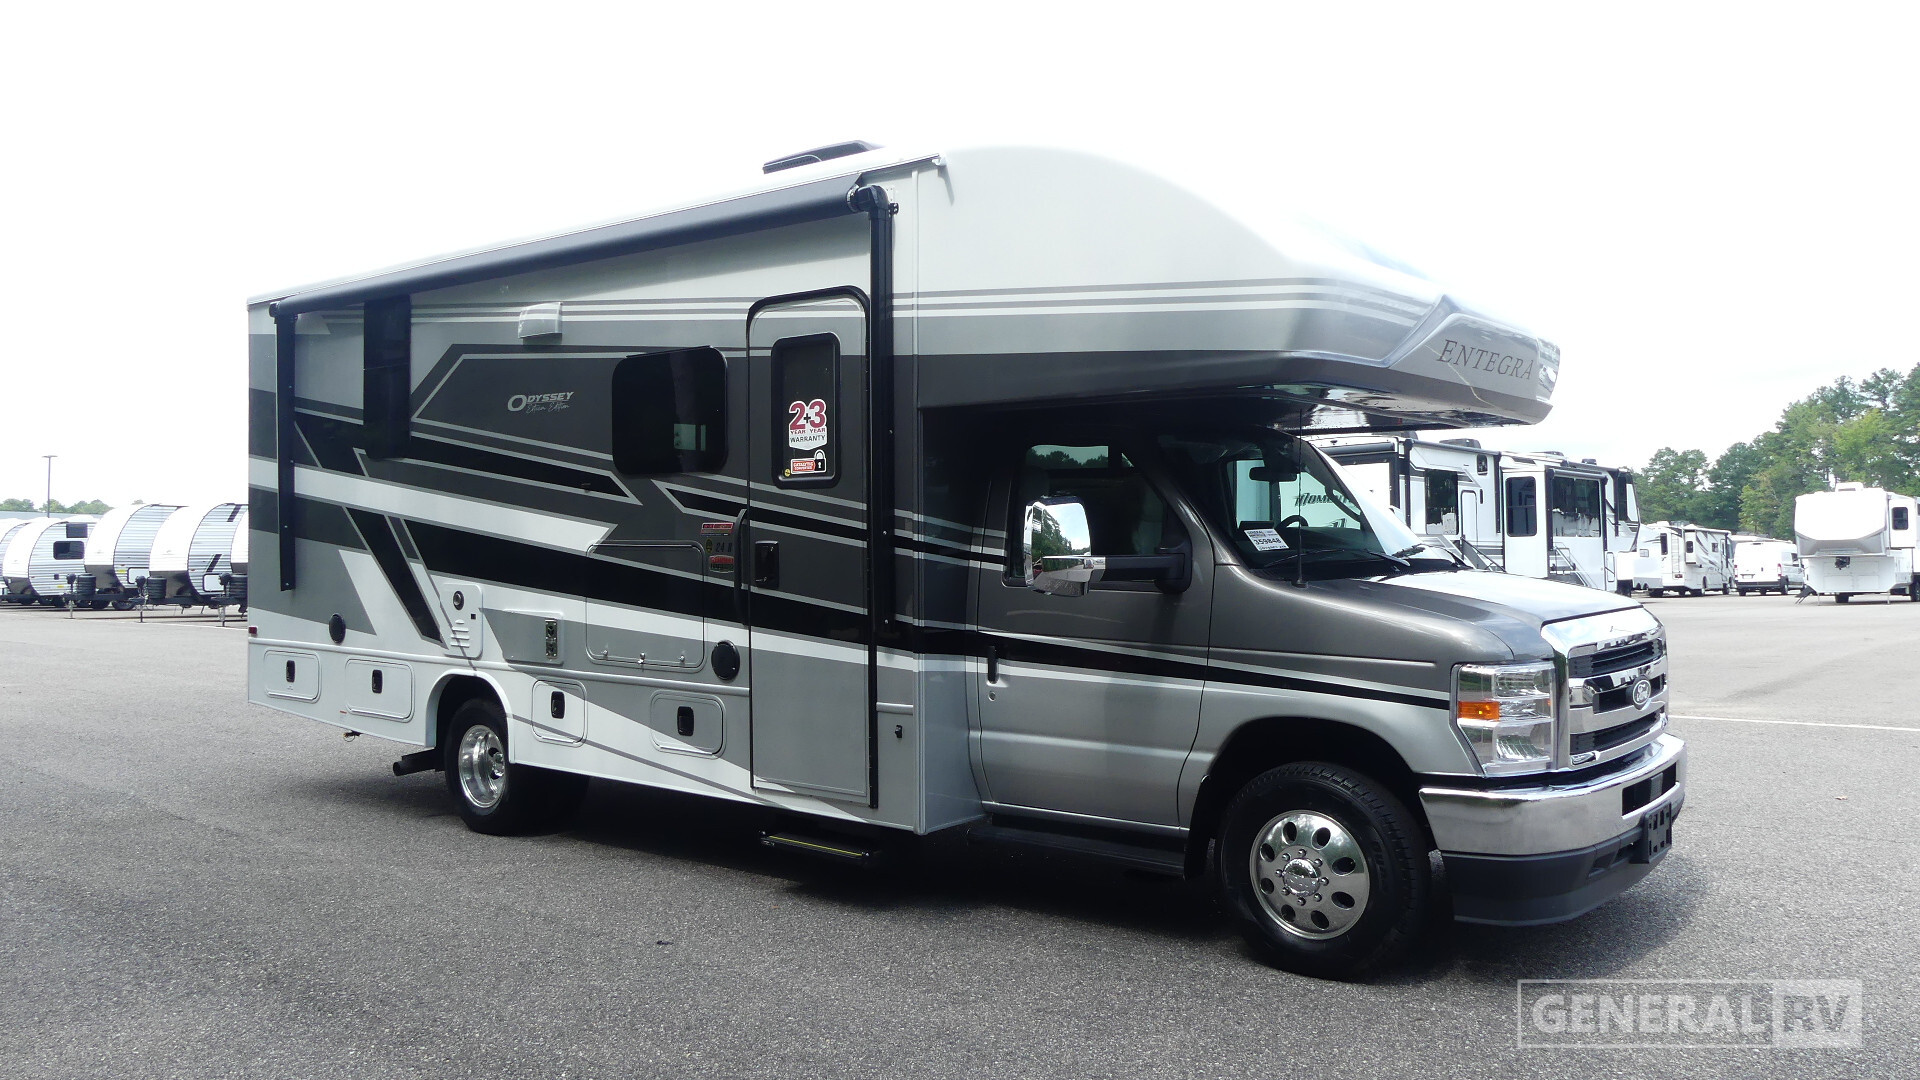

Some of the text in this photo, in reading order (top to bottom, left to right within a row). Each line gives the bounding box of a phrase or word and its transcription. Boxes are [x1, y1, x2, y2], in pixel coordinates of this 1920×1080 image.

[1435, 339, 1534, 380] ENTEGRA
[507, 391, 574, 412] ODYSSEY
[790, 435, 825, 443] WARRANTY
